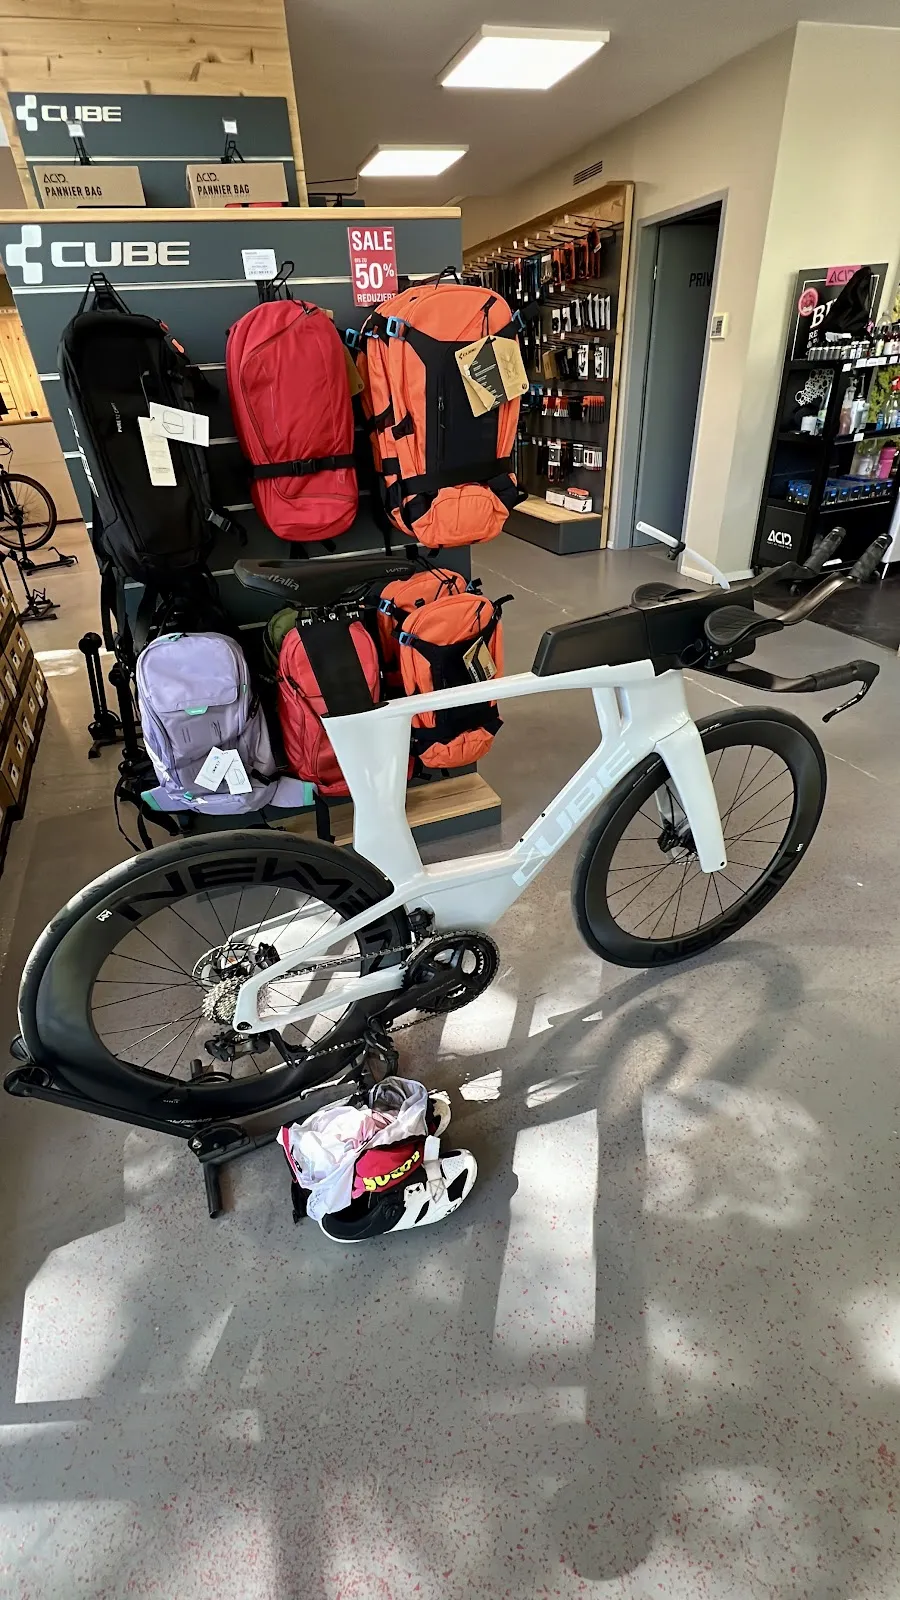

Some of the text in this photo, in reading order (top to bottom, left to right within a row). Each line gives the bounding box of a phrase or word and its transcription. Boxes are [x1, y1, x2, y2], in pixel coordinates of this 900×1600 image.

[41, 104, 122, 122] CUBE
[45, 186, 103, 197] PANNIER BAG
[197, 184, 250, 196] PANNIER BAG
[351, 230, 394, 251] SALE
[50, 241, 191, 268] CUBE
[354, 262, 395, 289] 50%
[357, 293, 396, 303] REDUZIERT
[268, 574, 300, 591] Italia
[511, 741, 636, 887] CUBE
